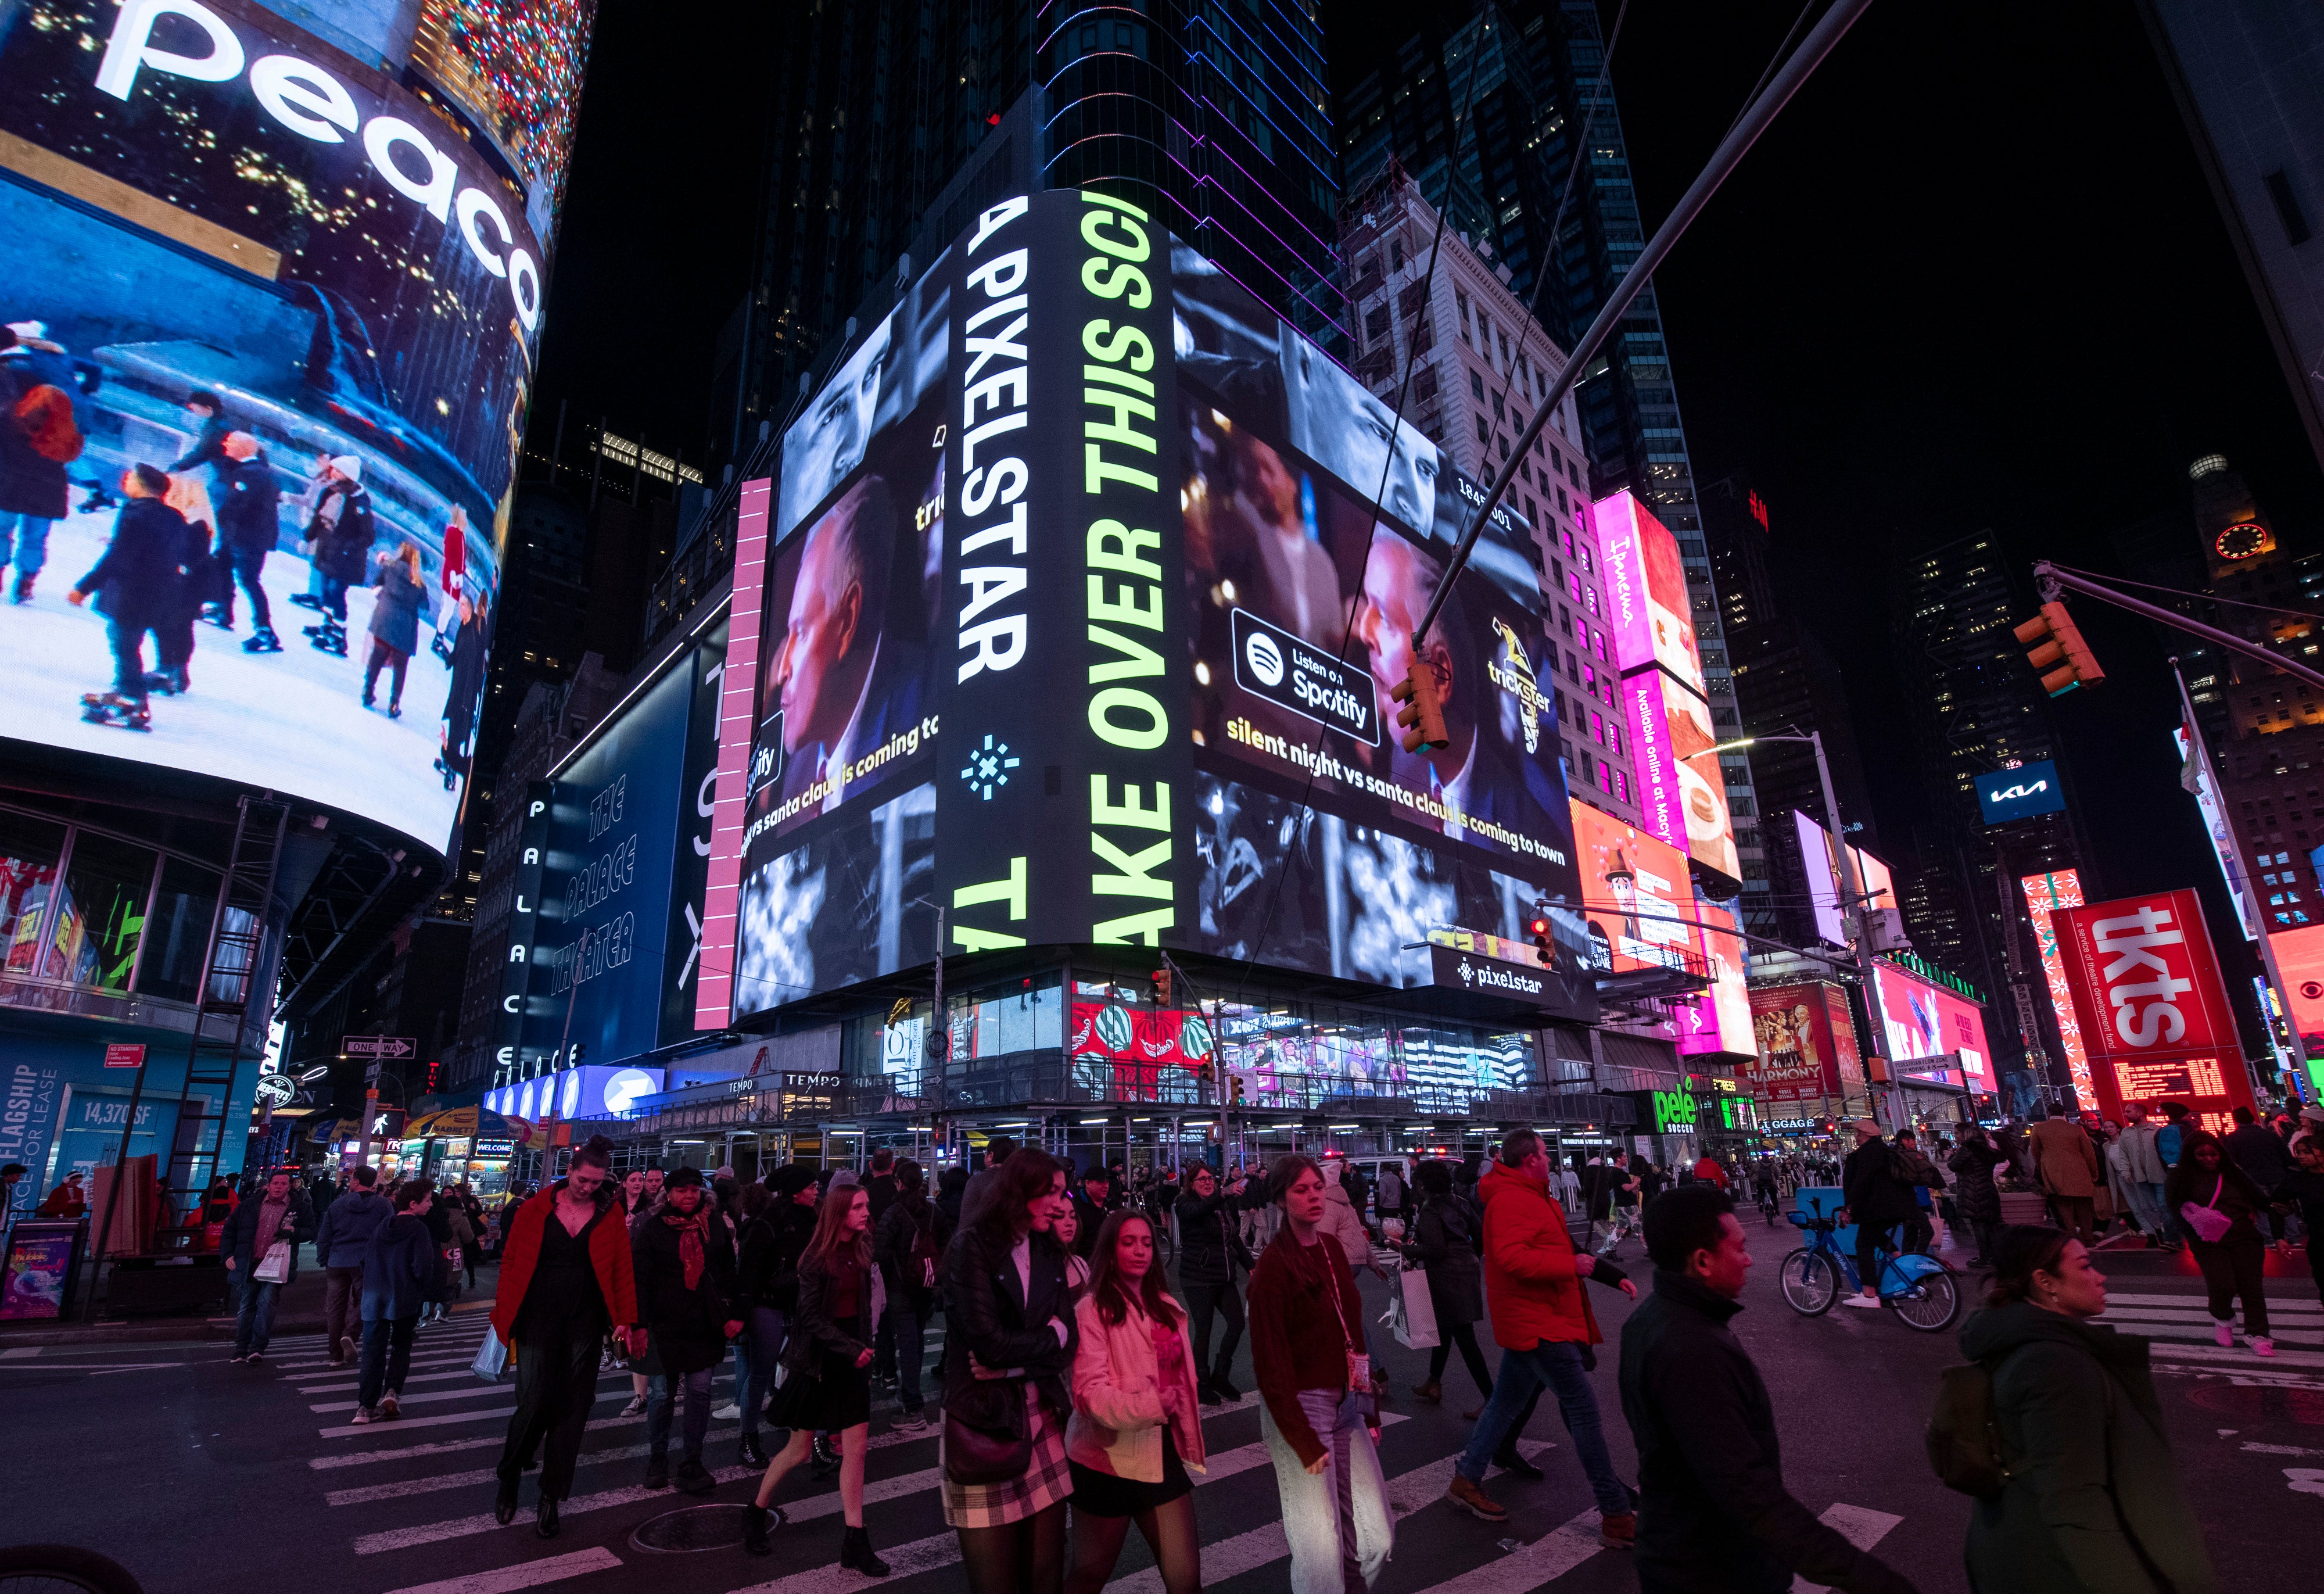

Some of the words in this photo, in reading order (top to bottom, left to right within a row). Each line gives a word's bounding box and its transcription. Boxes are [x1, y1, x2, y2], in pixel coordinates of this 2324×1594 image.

[1081, 191, 1152, 309] SC
[1082, 318, 1159, 494] THIS
[958, 248, 1028, 685] PIXELSTAR
[1604, 535, 1634, 629] Ipanema
[1087, 518, 1169, 748] OVER
[1293, 649, 1327, 677] Listen
[1329, 672, 1343, 686] on
[1488, 661, 1550, 714] trickster
[1293, 669, 1367, 729] Spotify
[1637, 689, 1655, 744] Available
[764, 796, 801, 831] santa
[842, 761, 853, 786] is
[856, 725, 919, 778] coming
[1647, 746, 1662, 784] online
[589, 774, 626, 843] THE
[1227, 718, 1287, 759] silent
[1290, 743, 1342, 780] night
[1344, 768, 1364, 788] vs
[1367, 776, 1414, 808] santa
[1416, 793, 1454, 823] claus
[1457, 808, 1468, 829] is
[1470, 816, 1519, 852] coming
[1519, 833, 1534, 853] to
[1534, 840, 1566, 866] town
[1653, 786, 1664, 801] at
[562, 833, 637, 925] PALACE
[497, 801, 545, 1065] PALACE
[551, 911, 634, 997] THEATER
[2078, 925, 2090, 952] service
[1477, 965, 1542, 994] pixelstar
[1918, 958, 1974, 998] BROADWAY
[2085, 954, 2094, 962] of
[2087, 962, 2099, 986] theatre
[2092, 906, 2192, 1047] tkts
[2093, 987, 2112, 1034] development
[2106, 1032, 2117, 1049] fund
[493, 1044, 578, 1091] PALACE
[729, 1077, 753, 1095] TEMPO
[787, 1071, 841, 1090] TEMPO
[1746, 1066, 1821, 1083] HARMONY
[0, 1065, 38, 1159] FLAGSHIP
[32, 1069, 58, 1123] LEASE
[85, 1102, 130, 1125] 14,370
[133, 1105, 152, 1125] SF
[21, 1130, 44, 1166] FOR
[433, 1125, 475, 1134] SABRETT
[478, 1144, 512, 1152] WELCOME
[1667, 1123, 1694, 1133] SOCCER
